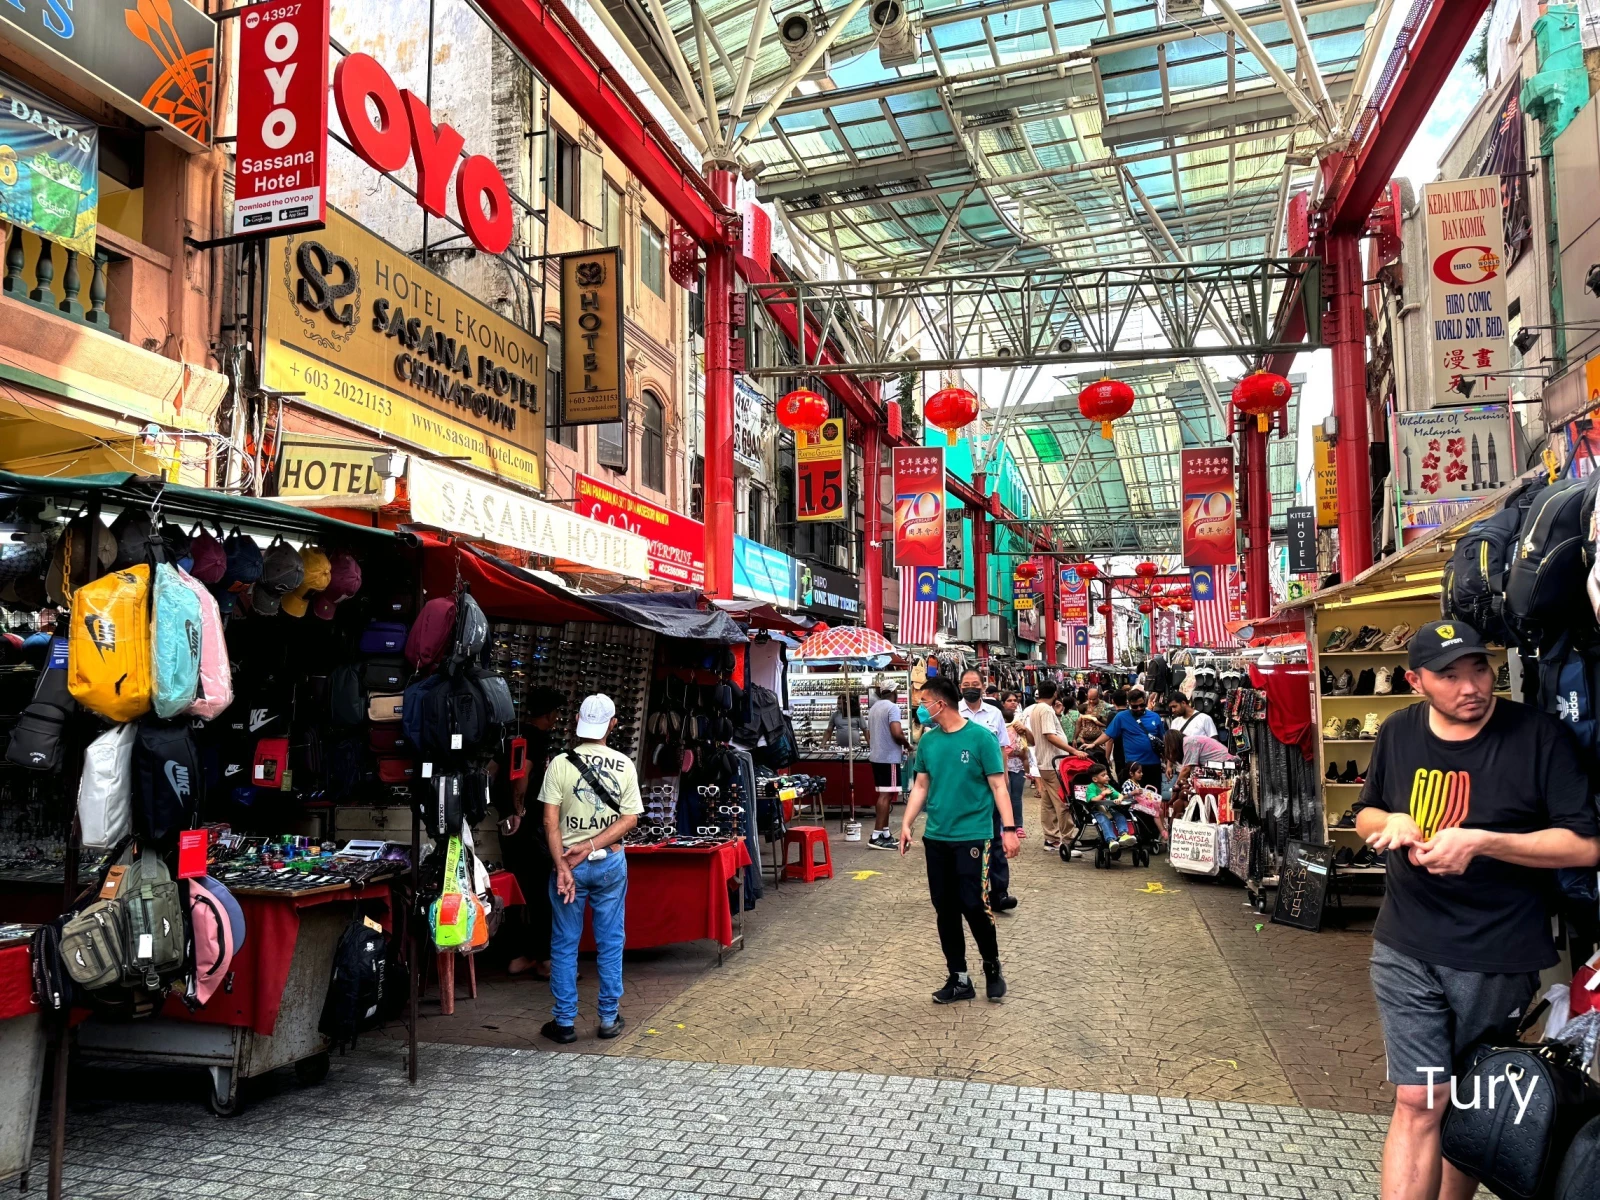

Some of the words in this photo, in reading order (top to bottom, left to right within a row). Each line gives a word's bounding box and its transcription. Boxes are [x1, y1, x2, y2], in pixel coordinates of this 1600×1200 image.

[262, 3, 301, 22] 43927
[261, 22, 299, 149] OYO
[9, 97, 91, 153] DARTS
[241, 150, 314, 175] Sassana
[334, 52, 513, 254] OYO
[254, 170, 300, 193] Hotel
[36, 193, 71, 217] Carlsberg
[239, 201, 270, 212] Download
[284, 195, 299, 204] OYO
[300, 194, 313, 203] app
[1427, 191, 1451, 215] KEDAI
[1452, 189, 1480, 214] MUZIK,
[1480, 187, 1496, 209] DVD
[1442, 218, 1457, 240] DAN
[1460, 216, 1486, 239] KOMIK
[1453, 262, 1471, 271] HIRO
[1446, 293, 1464, 314] HIRO
[1467, 290, 1492, 313] COMIC
[375, 259, 446, 324] HOTEL
[455, 308, 539, 377] EKONOMI
[1435, 318, 1462, 341] WORLD
[1465, 317, 1483, 339] SDN.
[1486, 316, 1505, 337] BHD.
[578, 291, 602, 391] HOTEL
[372, 297, 473, 379] SASANA
[477, 355, 540, 413] HOTEL
[1443, 347, 1495, 370] 漫畫
[304, 366, 329, 391] 603
[333, 379, 393, 417] 20221153
[394, 353, 517, 431] CHINATOWN
[587, 394, 618, 404] 20221153
[569, 404, 617, 413] www.sasanahotel.com
[1399, 414, 1444, 427] Wholesale
[1447, 413, 1458, 425] Of
[1463, 412, 1505, 422] Souvenirs
[411, 413, 535, 474] www.sasanahotel.com
[1414, 427, 1461, 439] Malaysia
[281, 458, 379, 495] HOTEL
[800, 470, 842, 511] 15
[896, 491, 941, 521] 70
[1185, 491, 1232, 521] 70
[1289, 511, 1312, 519] KITEZ
[441, 481, 557, 552] SASANA
[567, 520, 632, 571] HOTEL
[1297, 521, 1306, 567] HOTEL
[813, 574, 828, 589] HIRO
[814, 590, 827, 605] ONE
[190, 625, 199, 660] NIKE
[1569, 691, 1580, 723] adidas
[578, 753, 625, 773] TONE
[175, 764, 191, 796] NIKE
[566, 813, 619, 831] ISLAND
[1173, 833, 1210, 844] MALAYSIA
[1170, 852, 1190, 860] LOUSY
